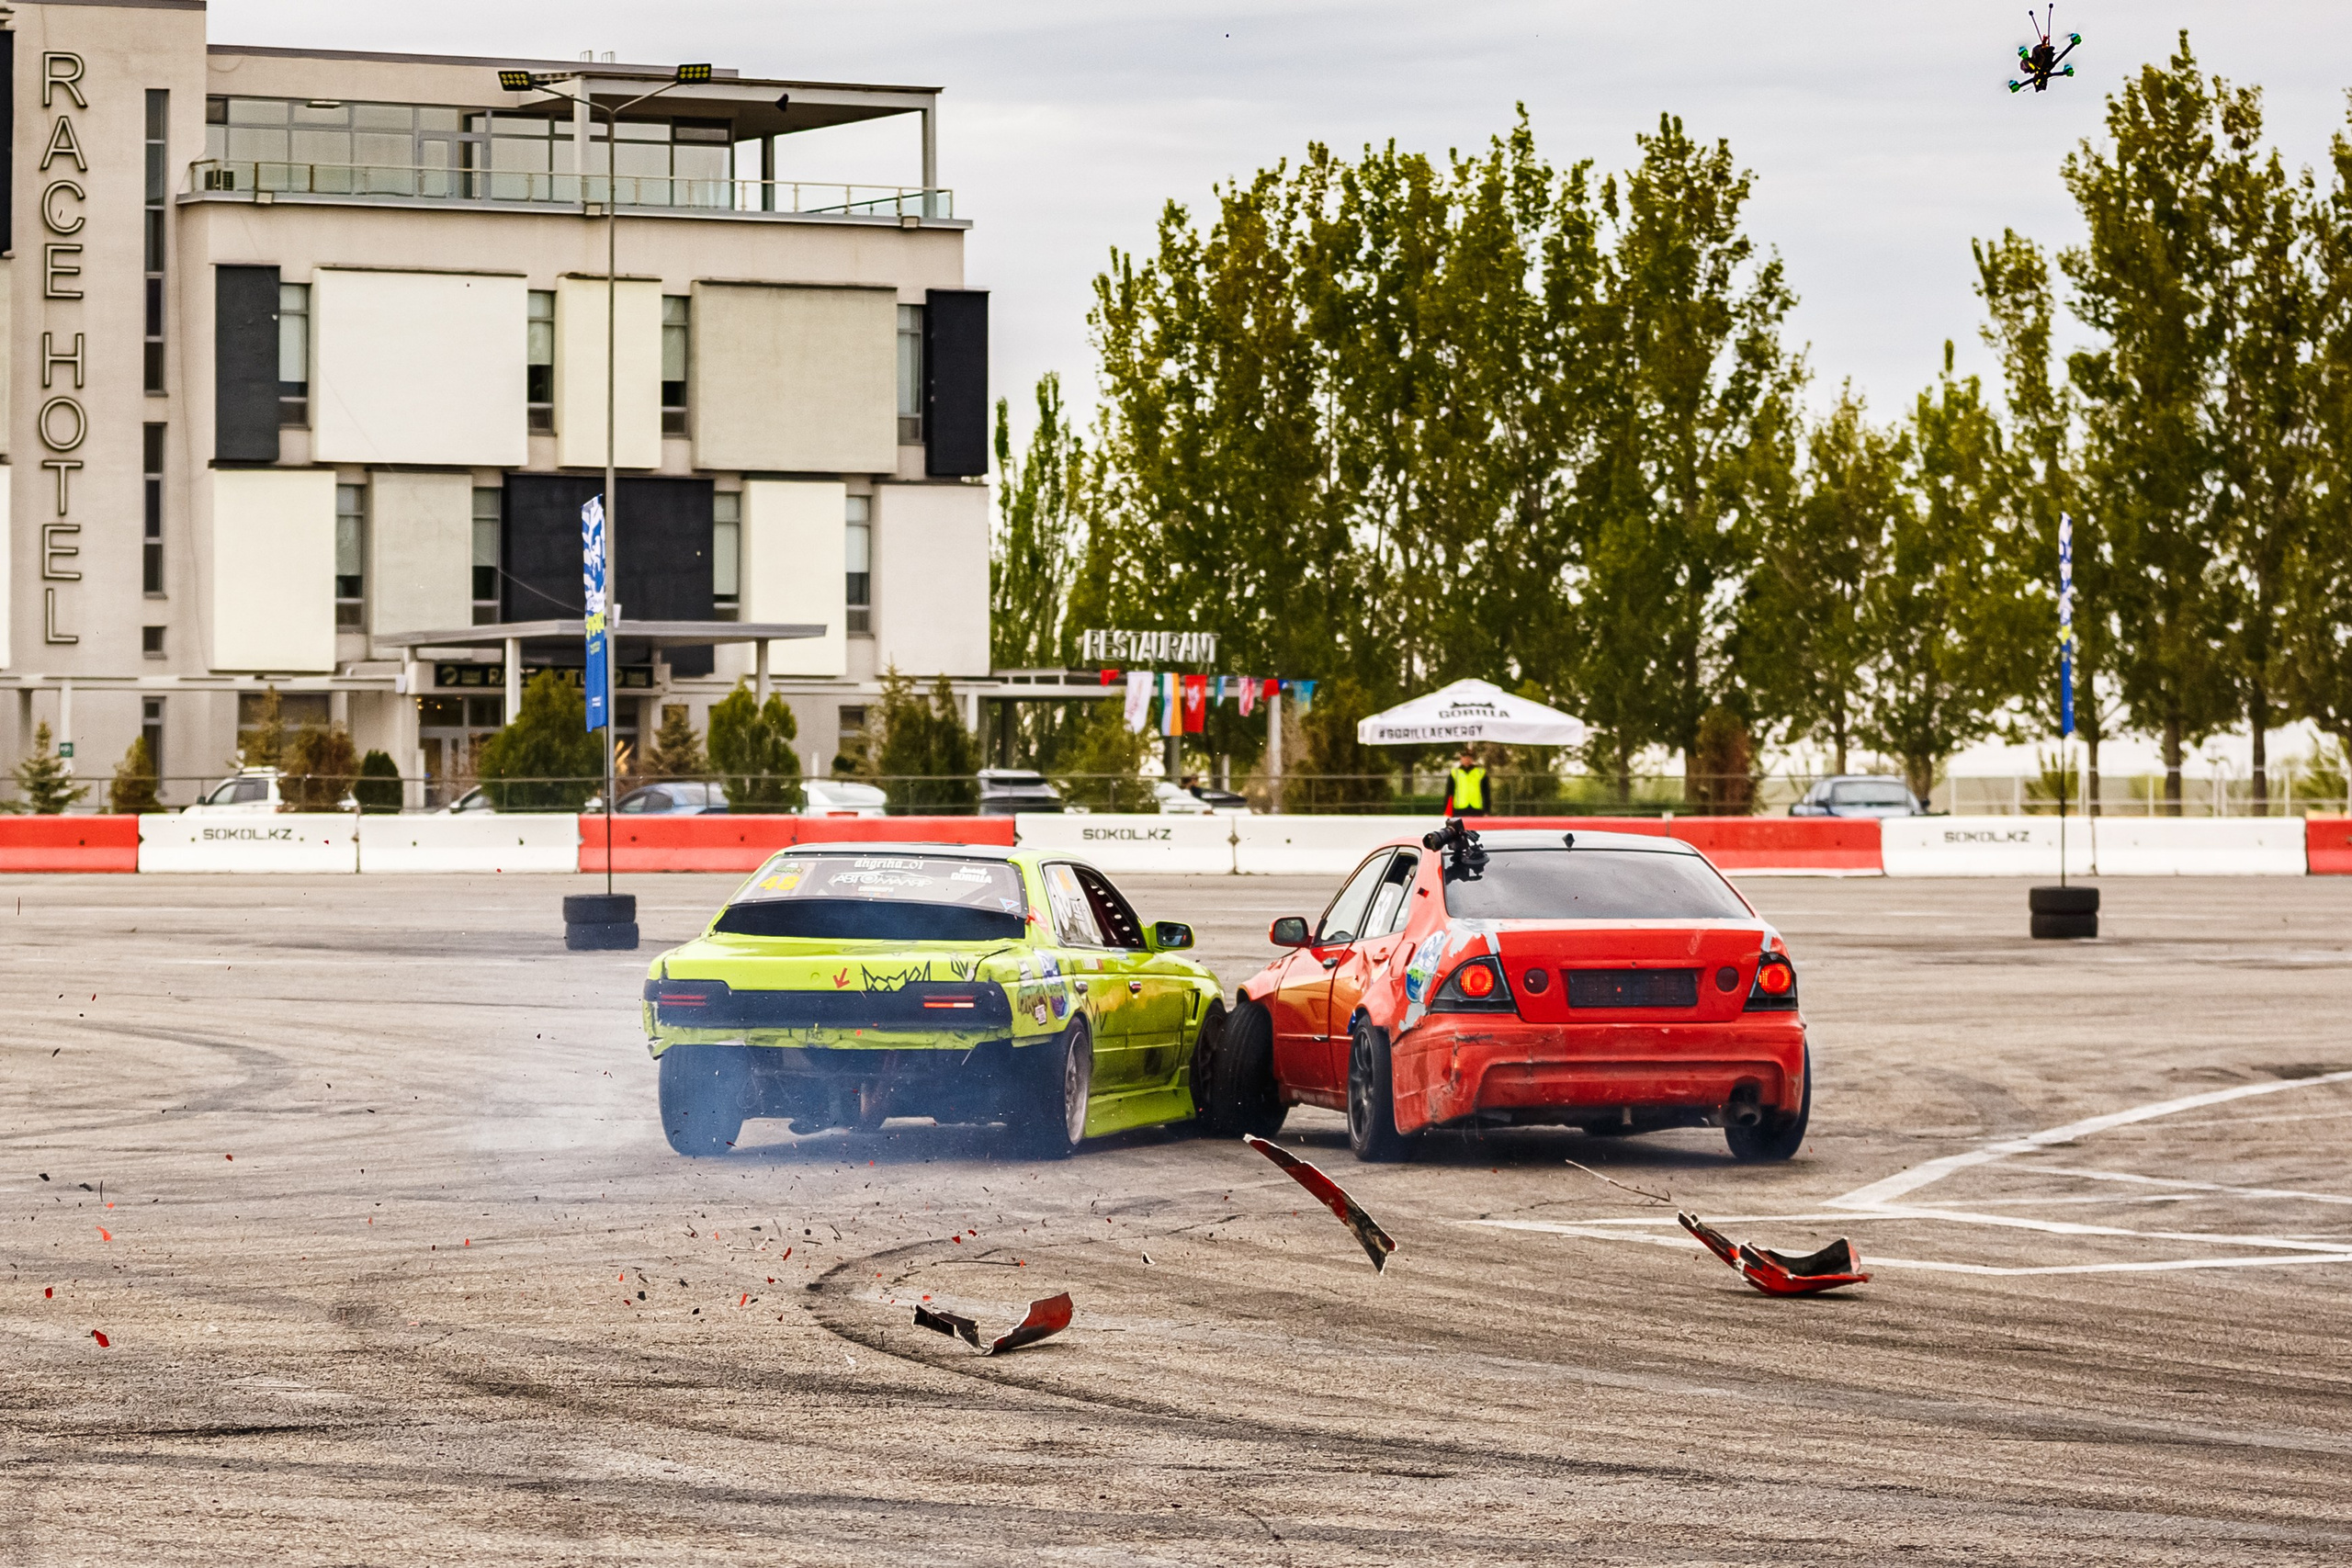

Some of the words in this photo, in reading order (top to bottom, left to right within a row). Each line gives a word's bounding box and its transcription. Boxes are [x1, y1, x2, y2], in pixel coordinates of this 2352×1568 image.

[41, 51, 87, 299] RACE
[38, 332, 87, 644] HOTEL
[1083, 628, 1221, 663] RESTAURANT
[1438, 708, 1510, 718] GORILLA
[1379, 725, 1484, 740] #GORILLAENERGY
[759, 875, 800, 890] 48
[950, 872, 992, 884] GORILLA
